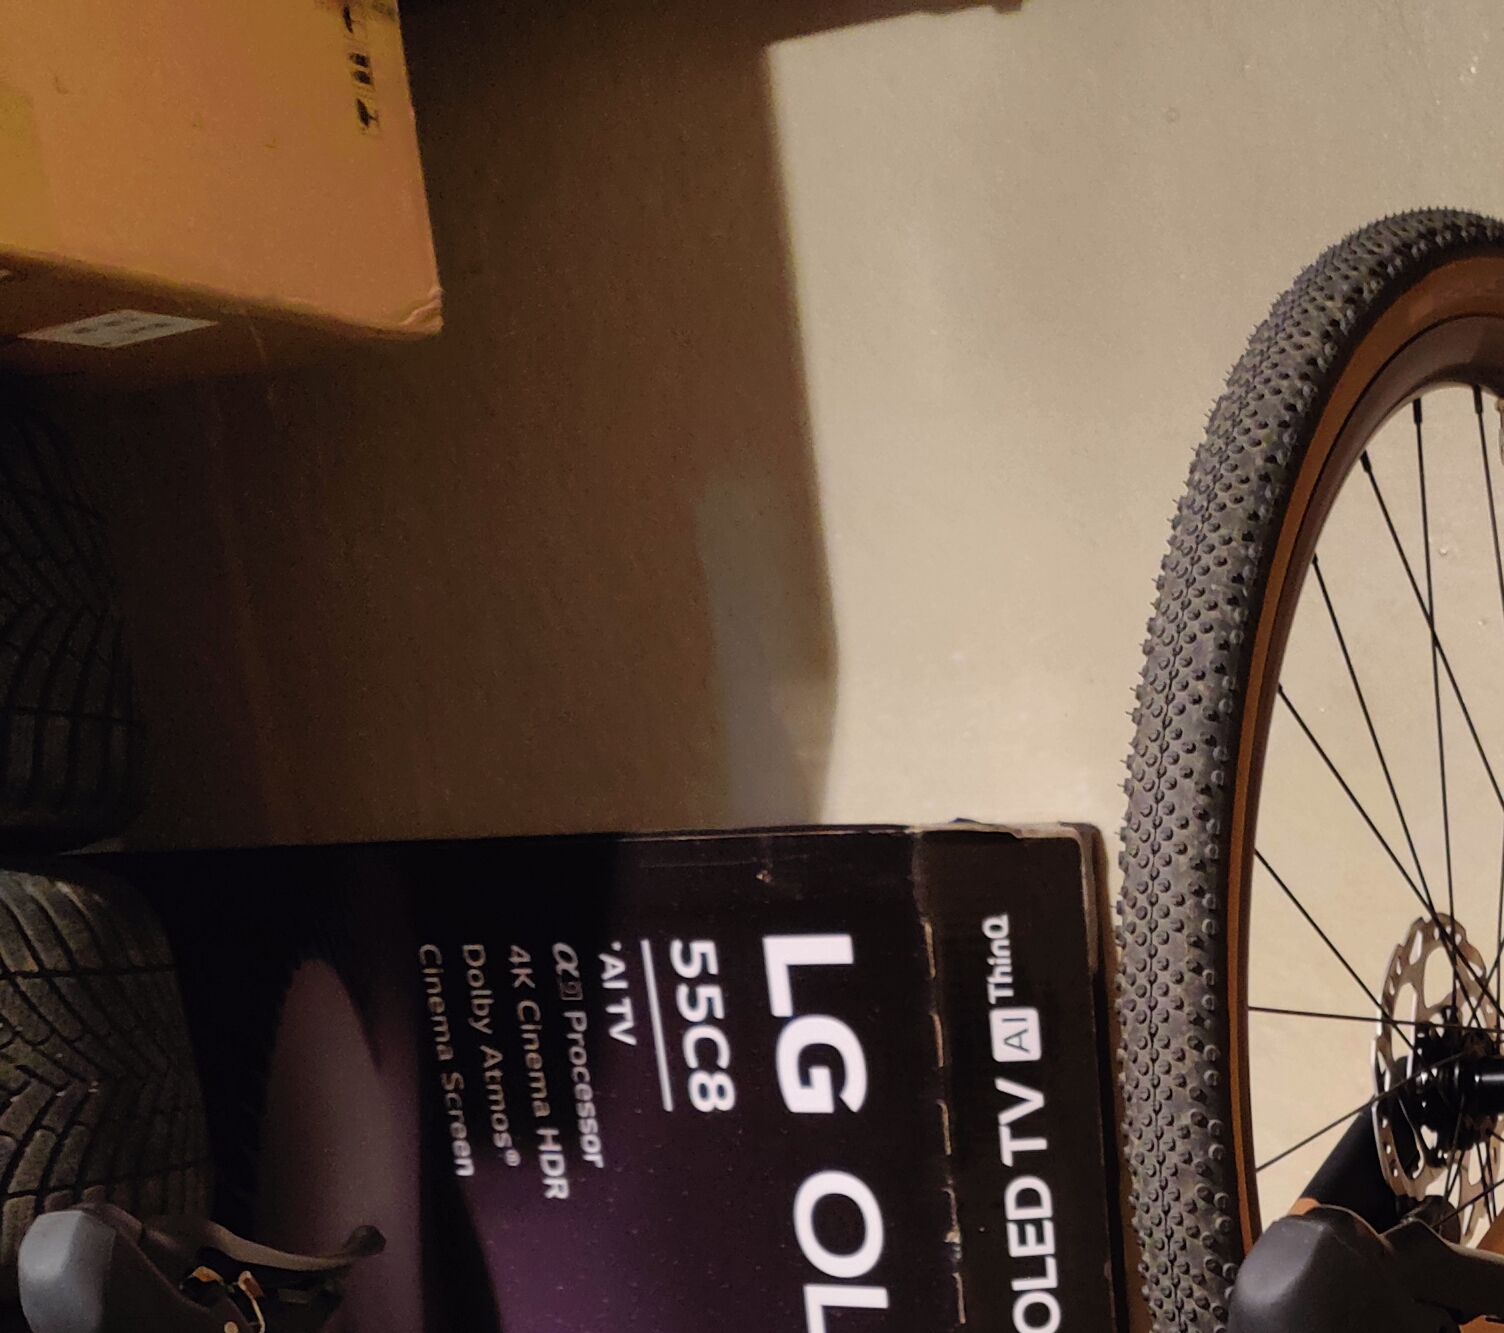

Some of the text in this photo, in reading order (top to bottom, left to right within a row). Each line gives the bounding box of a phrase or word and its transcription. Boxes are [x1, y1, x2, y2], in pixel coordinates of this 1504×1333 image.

[461, 943, 496, 1034] Dolby
[605, 997, 637, 1046] TV
[981, 913, 1016, 1005] ThinQ
[418, 943, 476, 1177] Cinema Screen
[507, 944, 569, 1200] 4K Cinema HDR
[669, 938, 737, 1113] 55C8
[763, 933, 868, 1114] LG
[1001, 1016, 1032, 1055] AI
[562, 1010, 605, 1169] Processor
[994, 1077, 1049, 1167] TV
